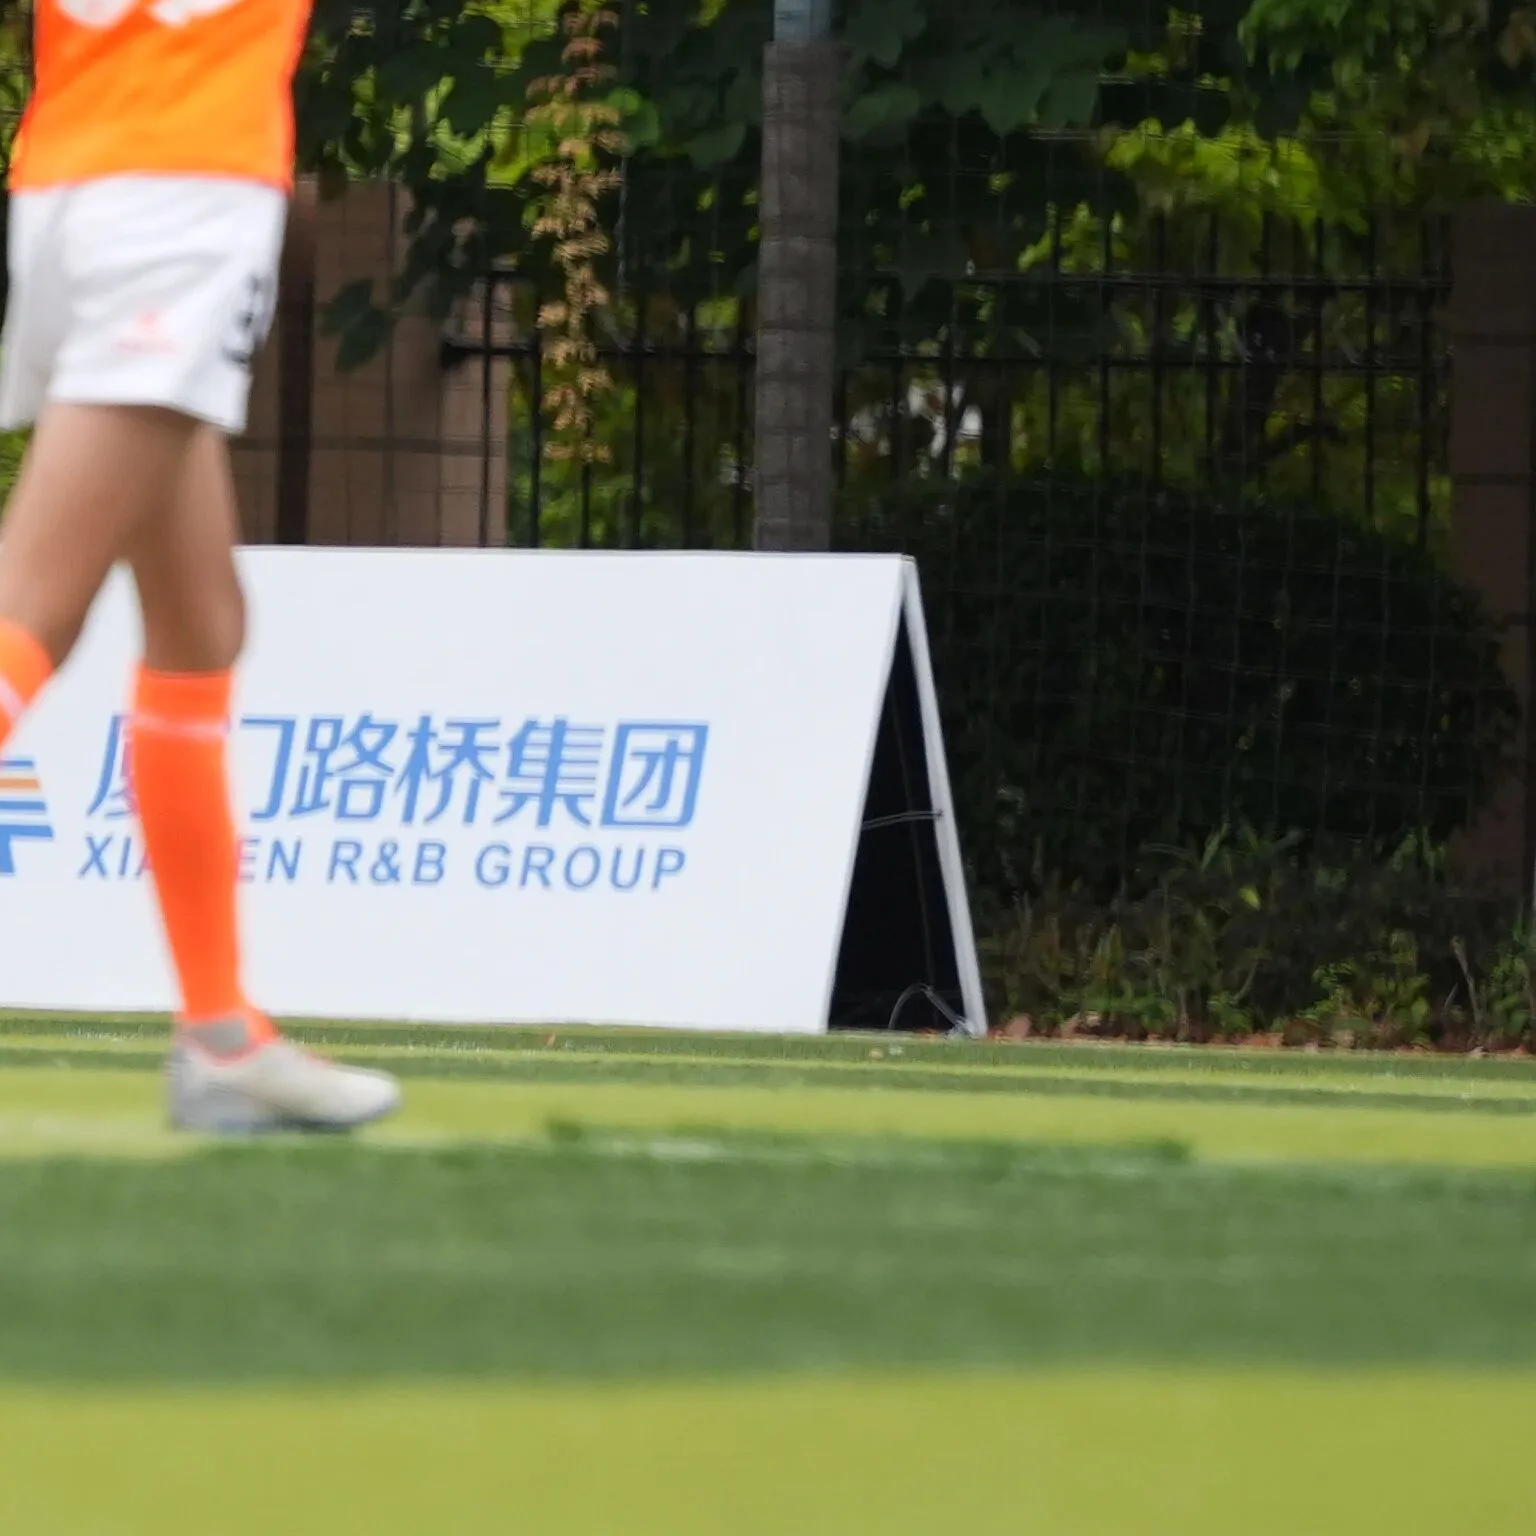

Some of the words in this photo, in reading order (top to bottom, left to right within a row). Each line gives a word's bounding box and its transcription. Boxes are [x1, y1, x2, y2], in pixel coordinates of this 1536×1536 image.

[77, 834, 303, 884] XIEN
[325, 838, 449, 887] R&B
[474, 843, 687, 892] GROUP
